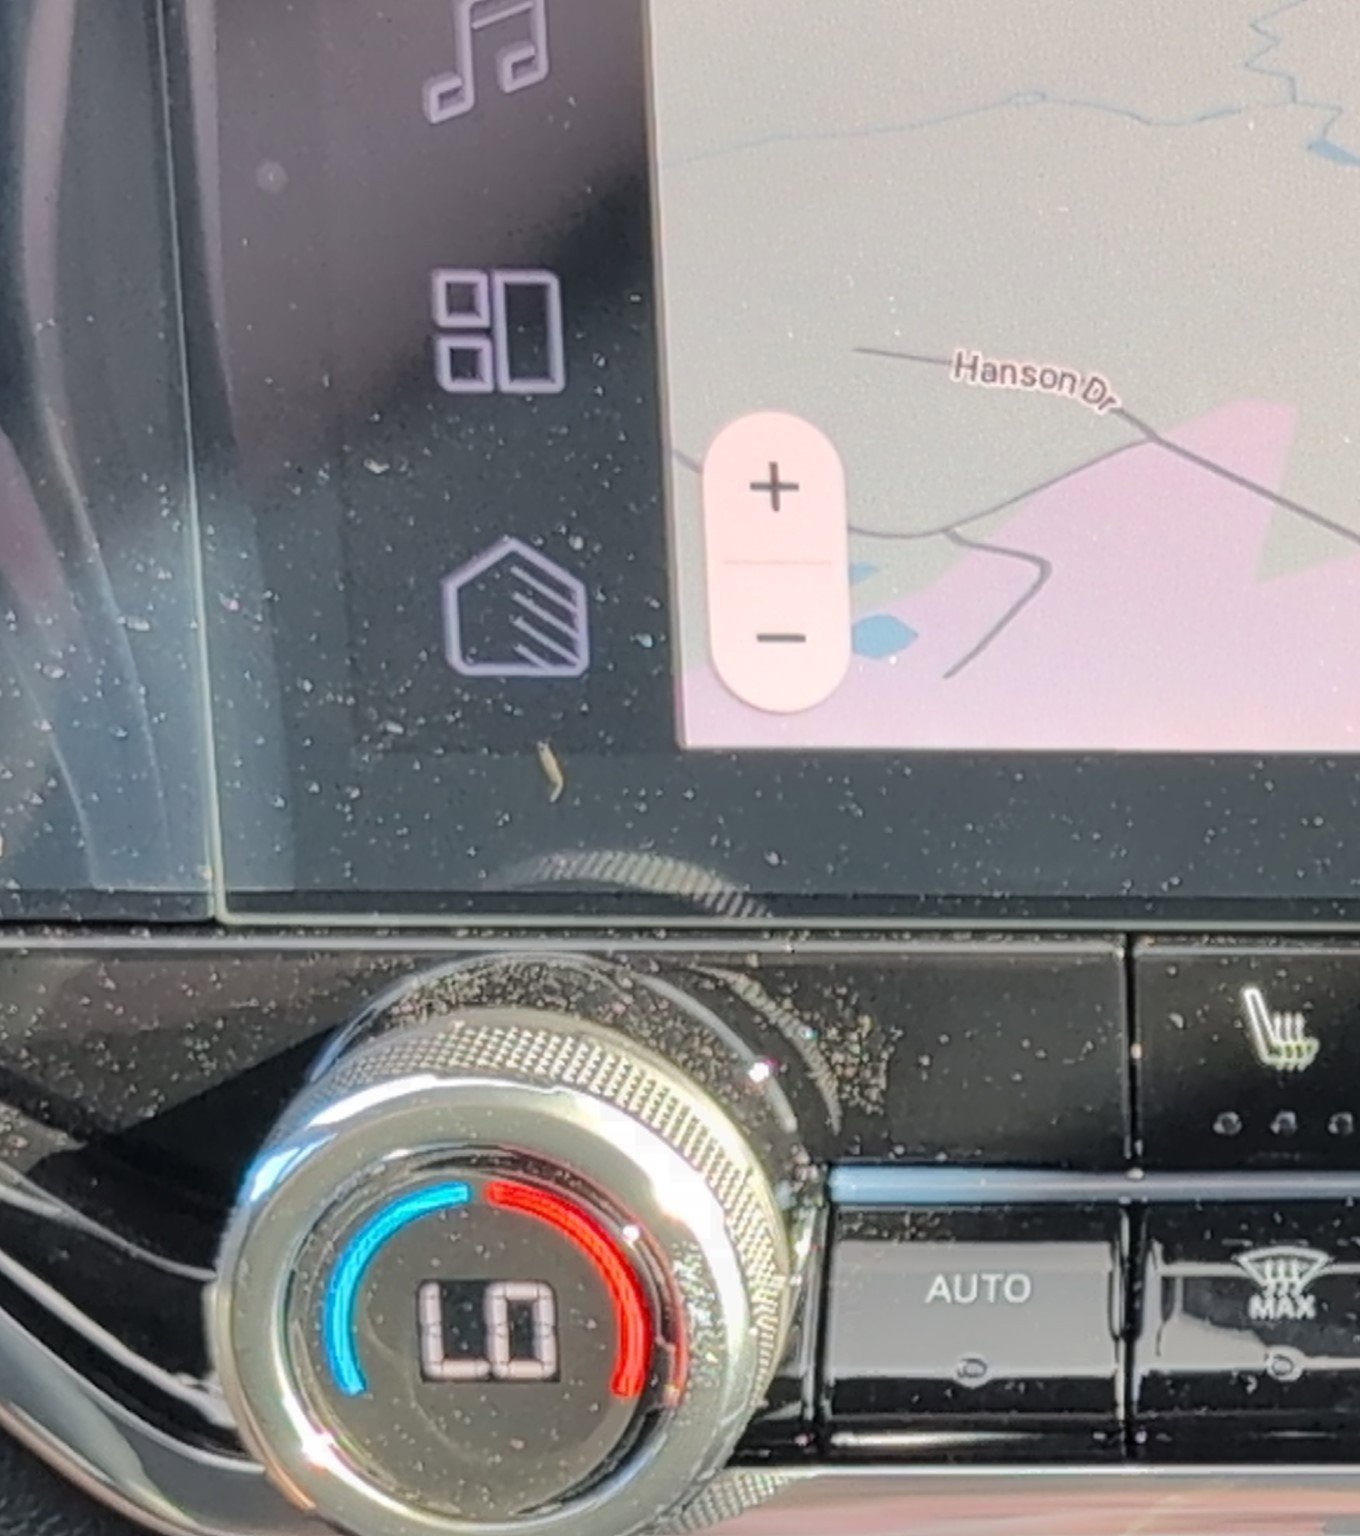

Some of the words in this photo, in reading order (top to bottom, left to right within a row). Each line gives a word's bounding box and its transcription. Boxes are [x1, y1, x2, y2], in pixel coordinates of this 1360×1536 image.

[955, 352, 1077, 394] Hanson
[1082, 377, 1116, 410] Dr
[926, 1273, 1032, 1304] AUTO
[1249, 1295, 1316, 1320] MAX
[419, 1282, 557, 1379] LO
